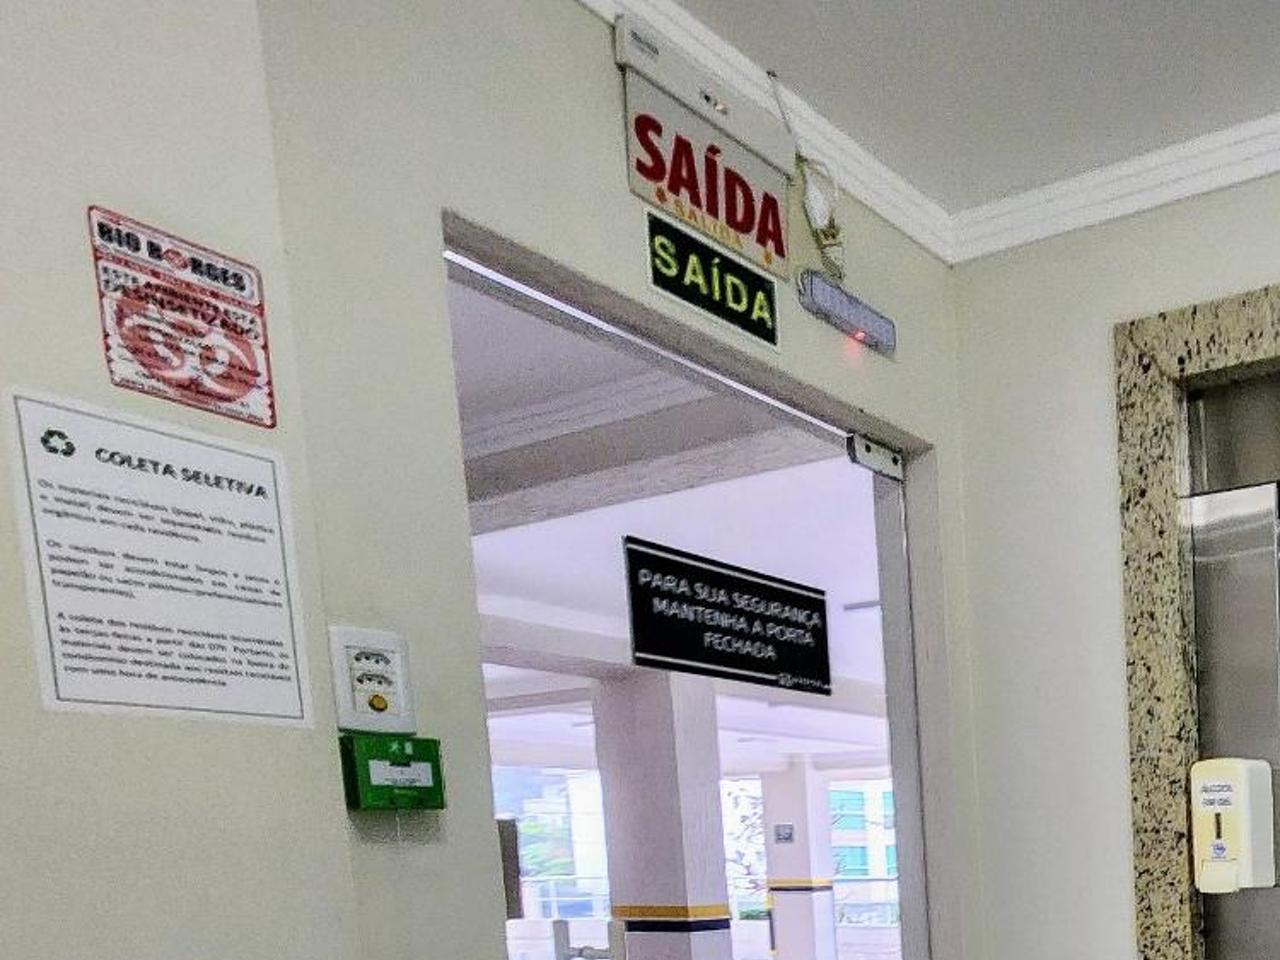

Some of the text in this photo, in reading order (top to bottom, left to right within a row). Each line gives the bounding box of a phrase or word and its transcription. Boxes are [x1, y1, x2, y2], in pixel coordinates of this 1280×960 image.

[633, 113, 787, 259] SAÍDA
[652, 235, 773, 327] SAÍDA
[94, 448, 268, 500] COLETA SELETIVA
[638, 568, 693, 597] PARA
[693, 582, 731, 605] SUA
[652, 596, 816, 647] MANTENHA A PORTA
[703, 631, 777, 661] FECHADA
